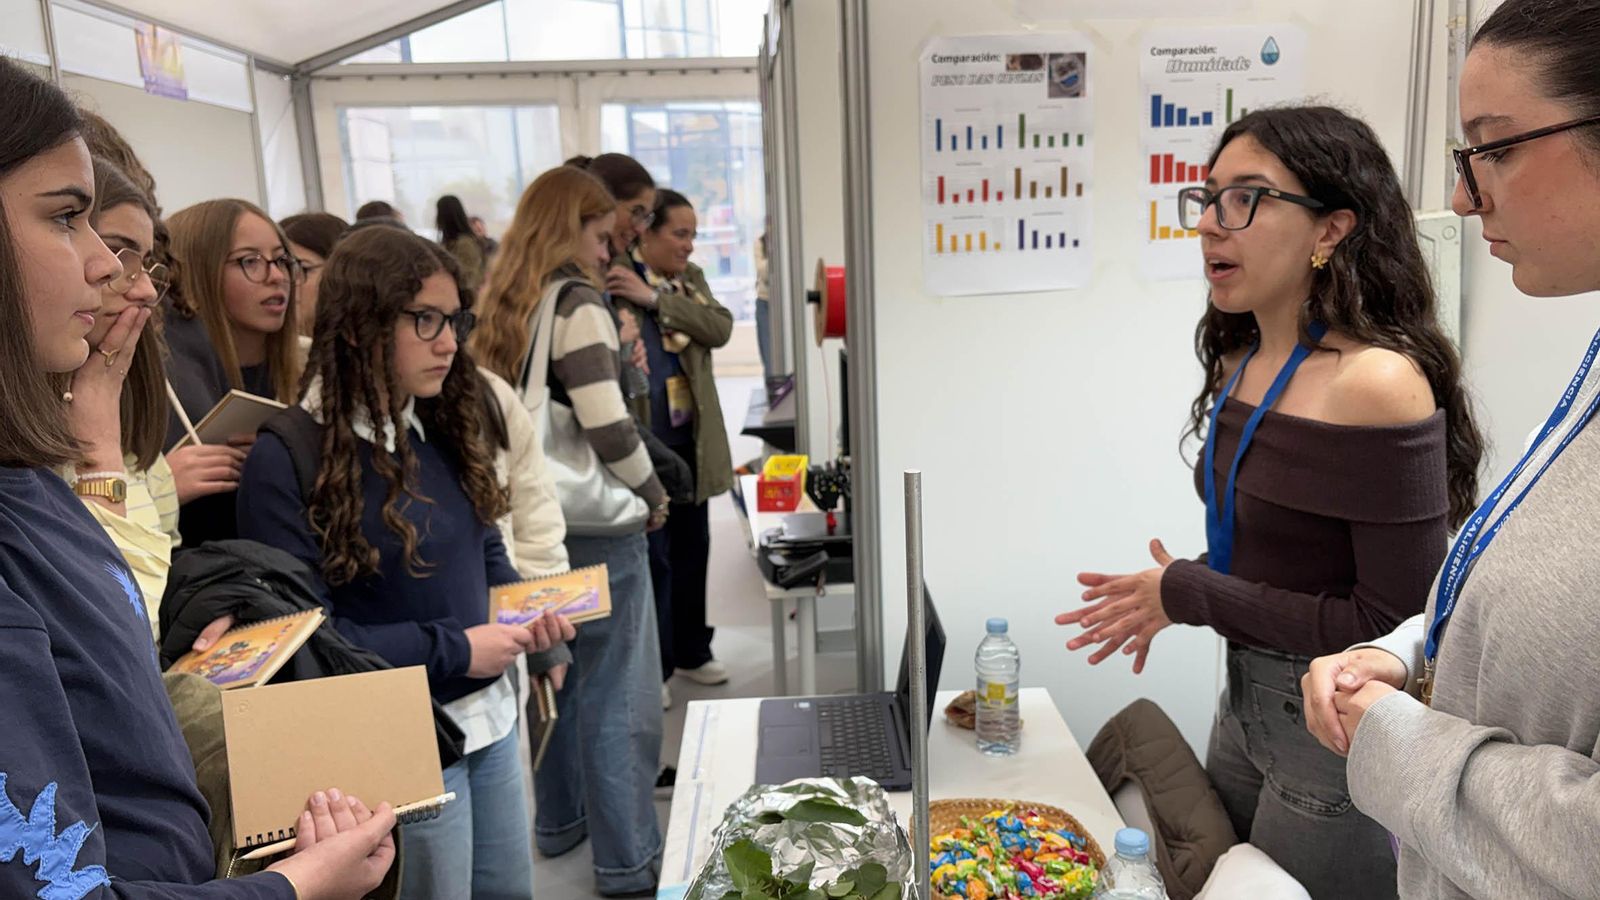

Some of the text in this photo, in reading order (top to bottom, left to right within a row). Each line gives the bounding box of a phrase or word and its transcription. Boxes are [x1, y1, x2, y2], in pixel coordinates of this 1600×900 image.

[931, 53, 1001, 65] Comparación:
[1150, 46, 1217, 58] Comparación:
[1165, 56, 1252, 74] Humidade
[1560, 332, 1600, 408] ALICIENCIA
